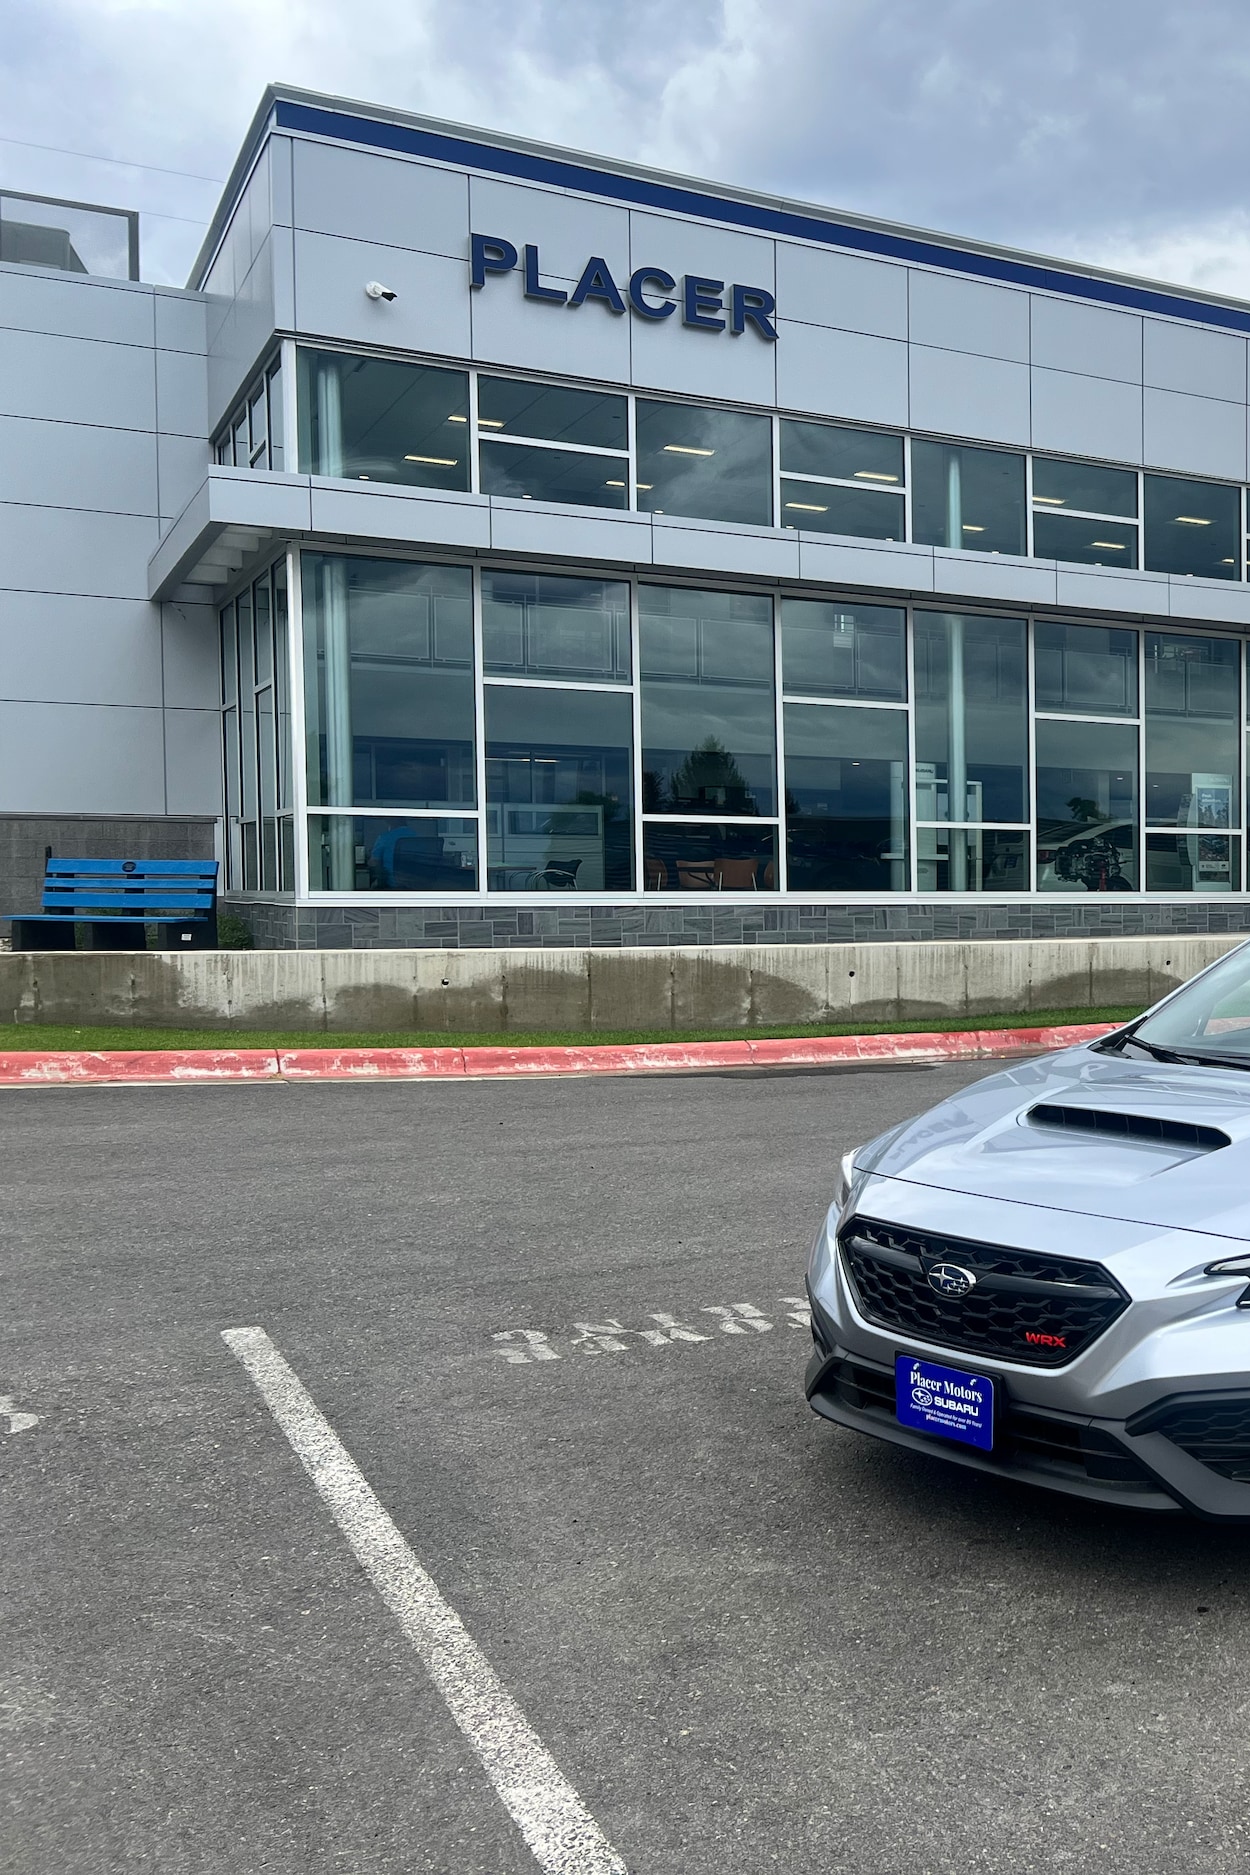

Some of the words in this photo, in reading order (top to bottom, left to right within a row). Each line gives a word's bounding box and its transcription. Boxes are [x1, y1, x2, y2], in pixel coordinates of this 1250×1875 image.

[470, 232, 779, 340] PLACER
[1025, 1331, 1066, 1348] WRX
[910, 1371, 942, 1392] Placer
[943, 1380, 983, 1403] Motors
[934, 1396, 979, 1417] SUBARU
